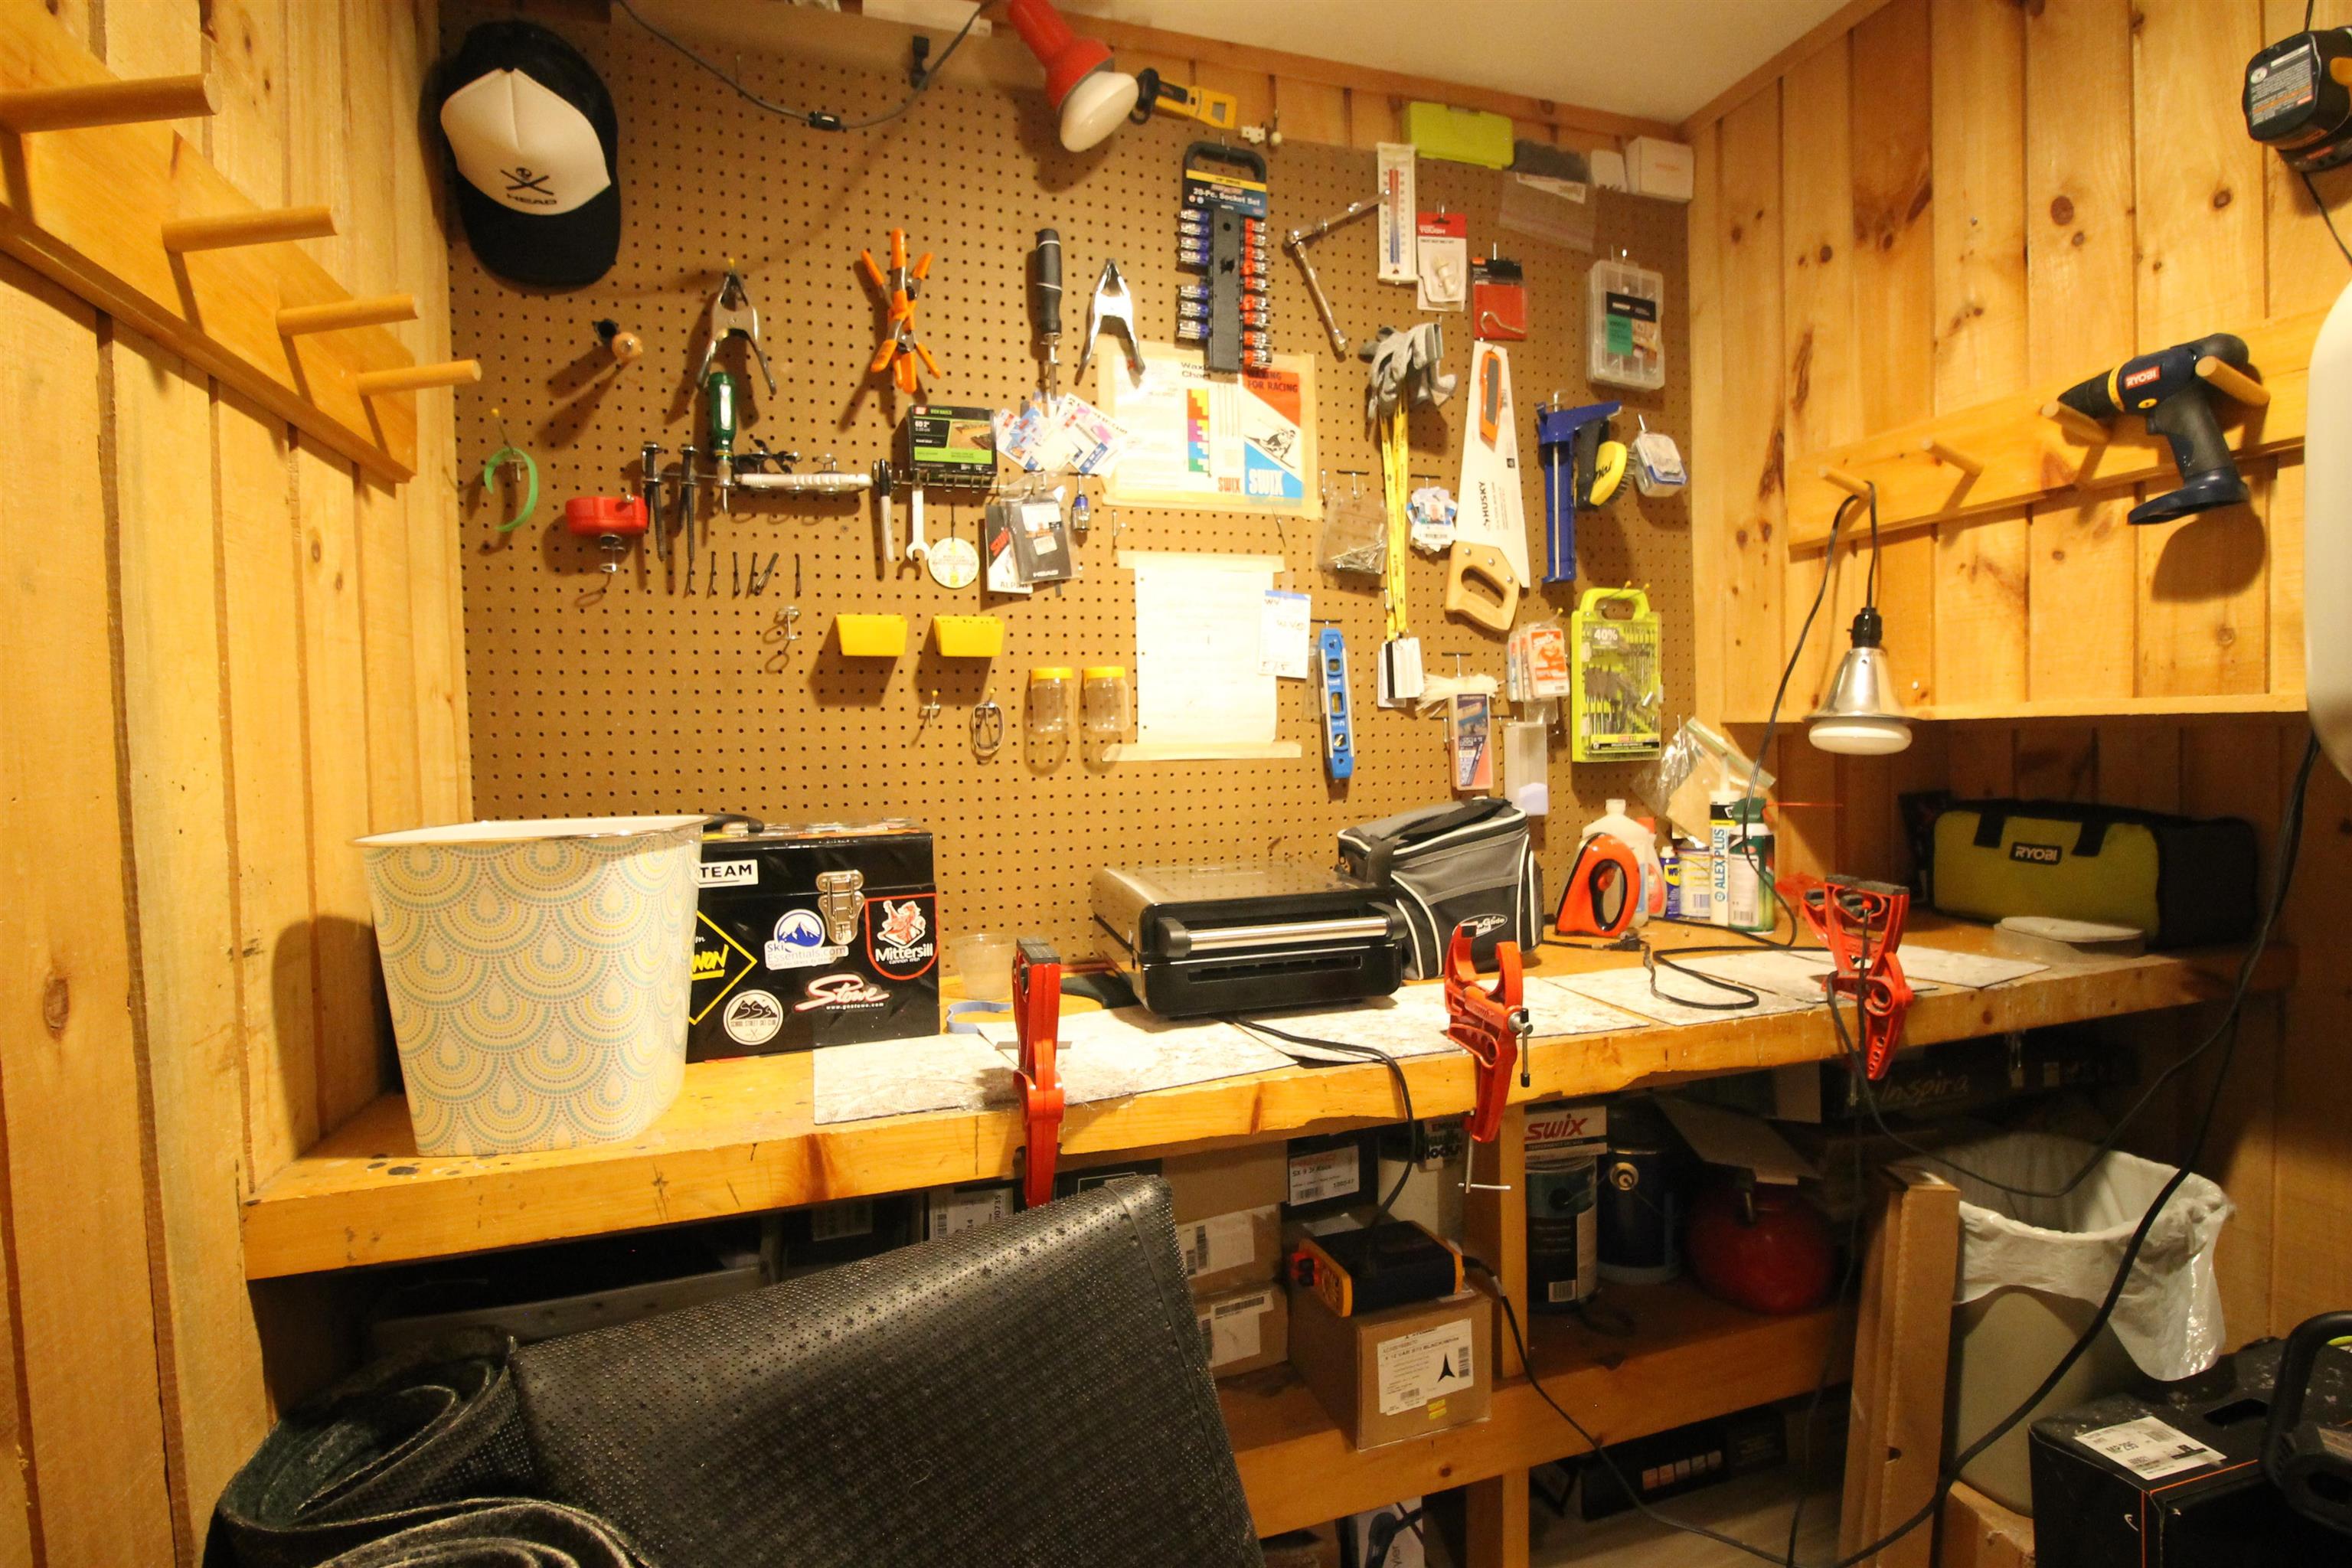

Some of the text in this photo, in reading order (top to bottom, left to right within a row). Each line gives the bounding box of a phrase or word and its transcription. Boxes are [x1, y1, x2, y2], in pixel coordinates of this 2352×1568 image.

[506, 192, 557, 205] HEAD
[1219, 191, 1246, 204] Socket
[1247, 197, 1260, 207] Set
[1247, 380, 1298, 393] FOR RACING
[2125, 370, 2157, 387] RYOBI
[1217, 476, 1241, 494] SWIX
[1249, 468, 1284, 496] SWIX
[1478, 481, 1489, 518] HUSKY
[1593, 629, 1618, 641] 40%
[1713, 828, 1726, 890] ALEX PLUS
[2014, 845, 2058, 862] RYOBI
[700, 864, 752, 878] TEAM
[767, 942, 784, 952] Ski
[767, 947, 845, 962] Essentials.com
[875, 942, 933, 962] Mittersill
[793, 973, 890, 1011] Stowe
